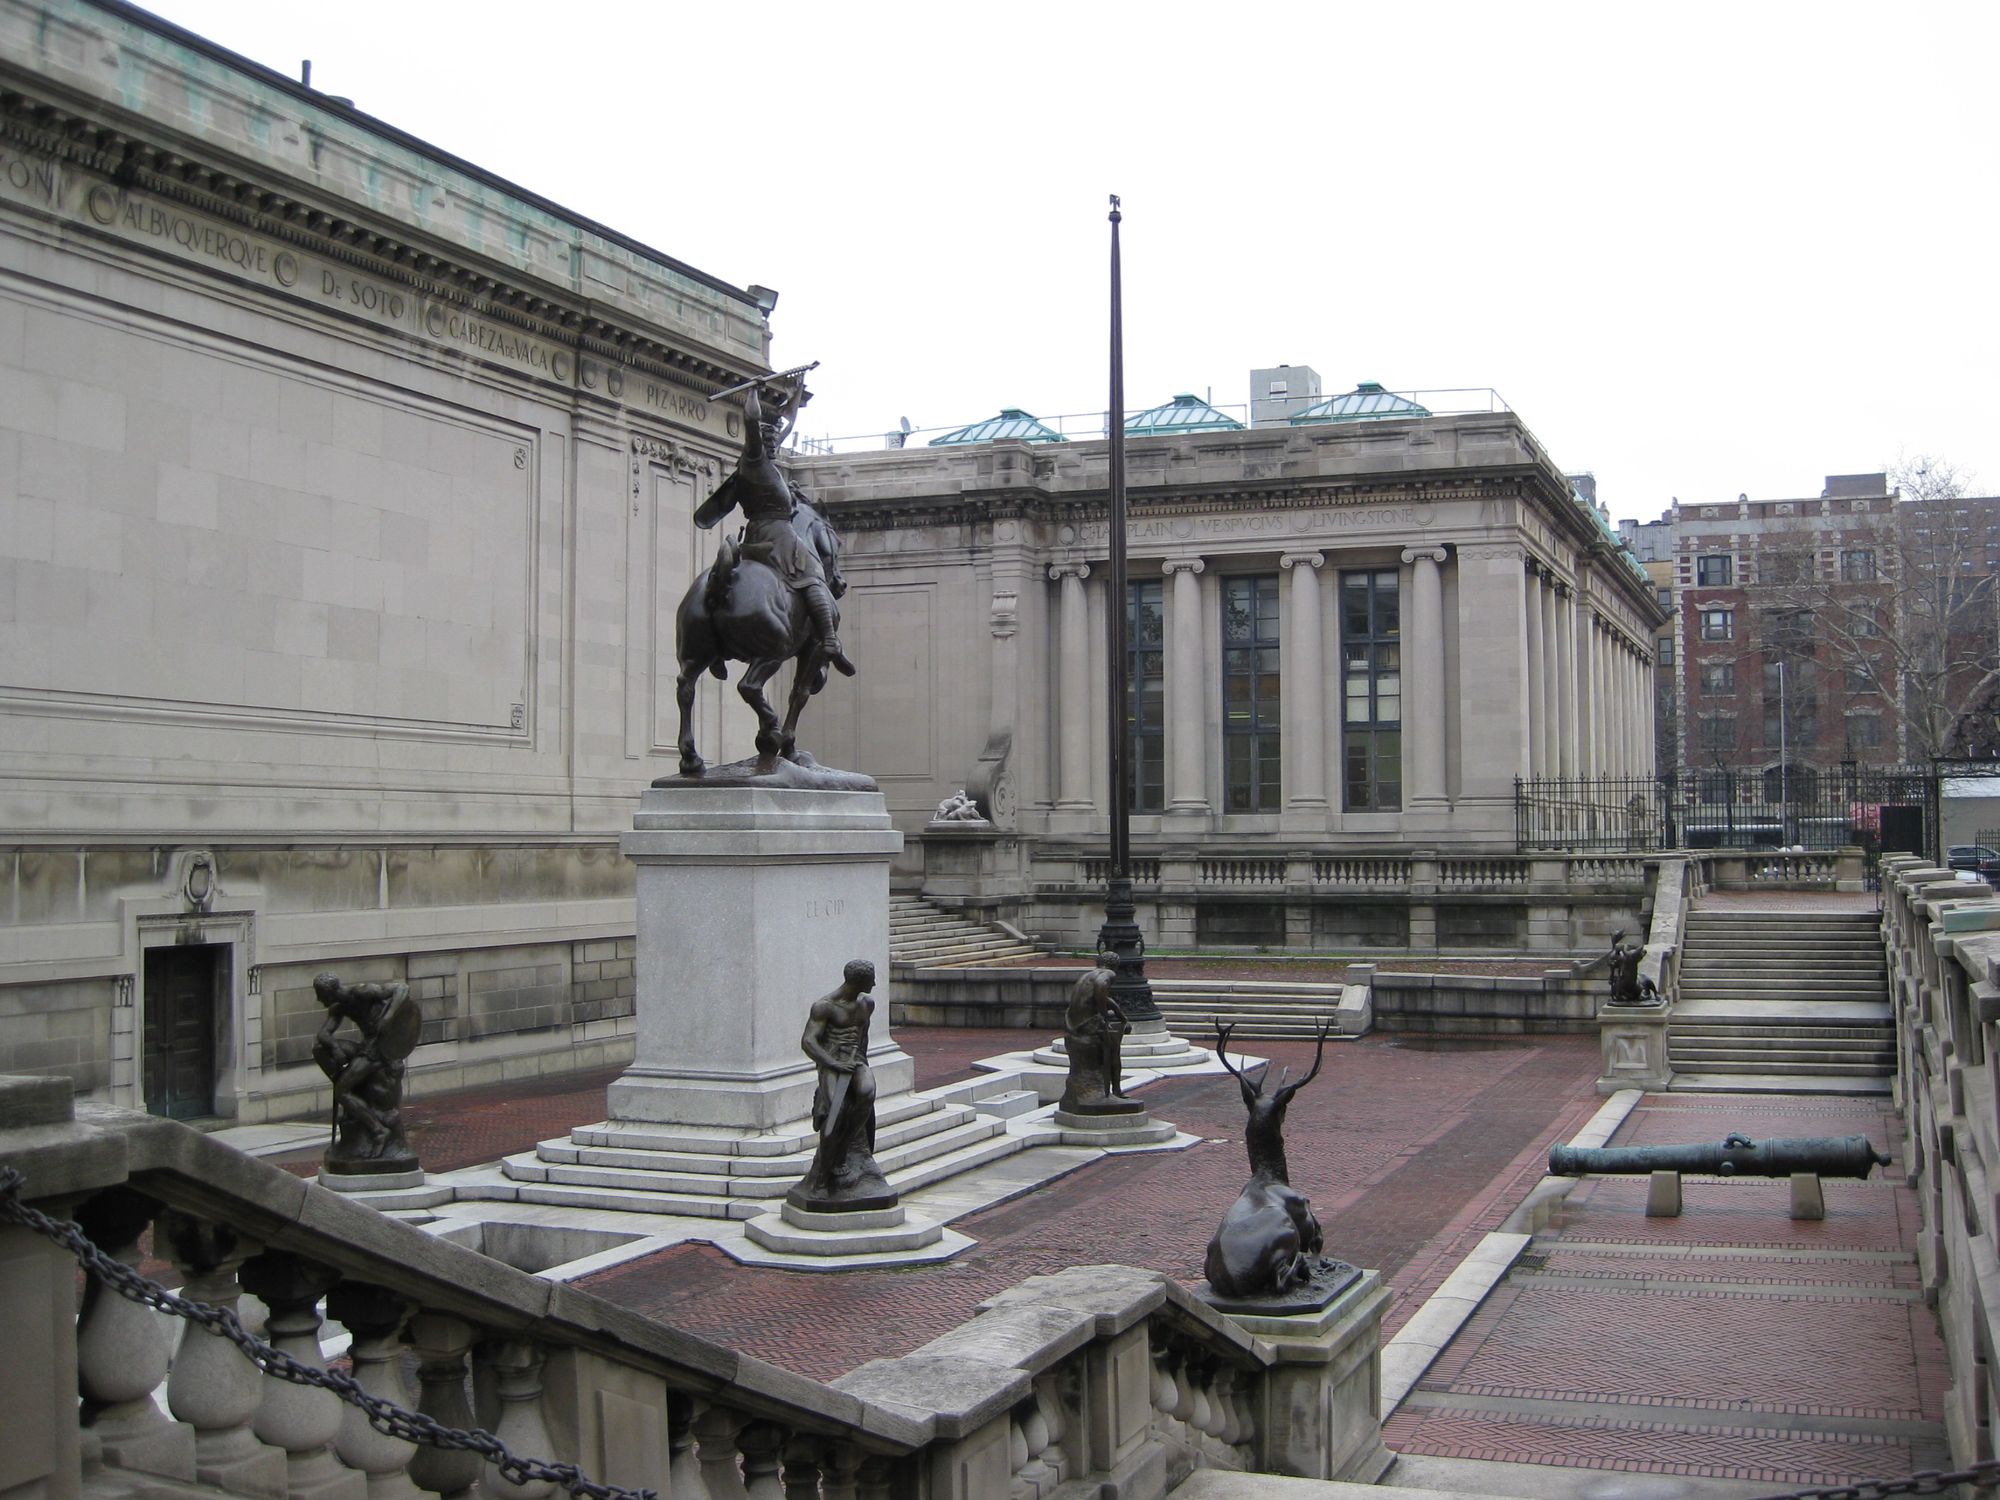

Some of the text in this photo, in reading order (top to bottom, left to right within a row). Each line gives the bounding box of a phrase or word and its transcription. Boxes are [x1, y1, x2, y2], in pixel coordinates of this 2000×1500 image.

[0, 160, 54, 204] ON
[350, 281, 404, 319] SOTO
[647, 384, 706, 422] PIZARRO
[1079, 521, 1174, 541] CHAPLAIN
[1312, 509, 1413, 528] LIVINGSTONE
